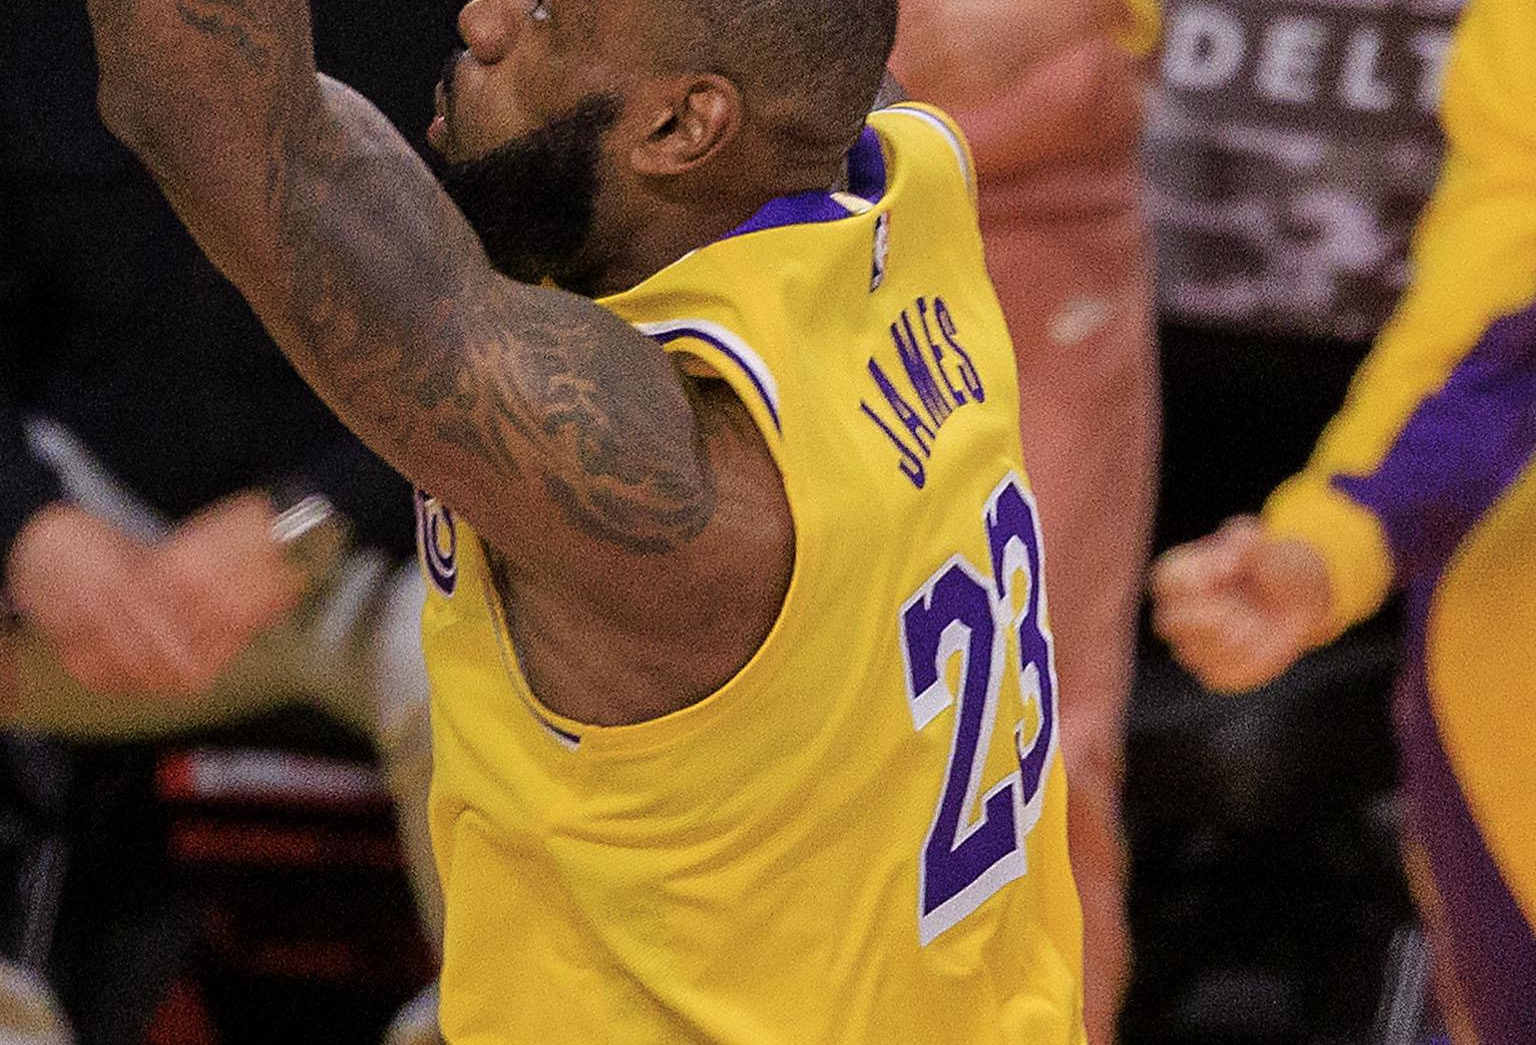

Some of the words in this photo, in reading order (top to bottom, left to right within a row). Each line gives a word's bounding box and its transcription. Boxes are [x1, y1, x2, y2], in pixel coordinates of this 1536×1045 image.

[1164, 2, 1452, 112] DELT
[860, 296, 985, 490] JAMES
[900, 470, 1059, 948] 23
